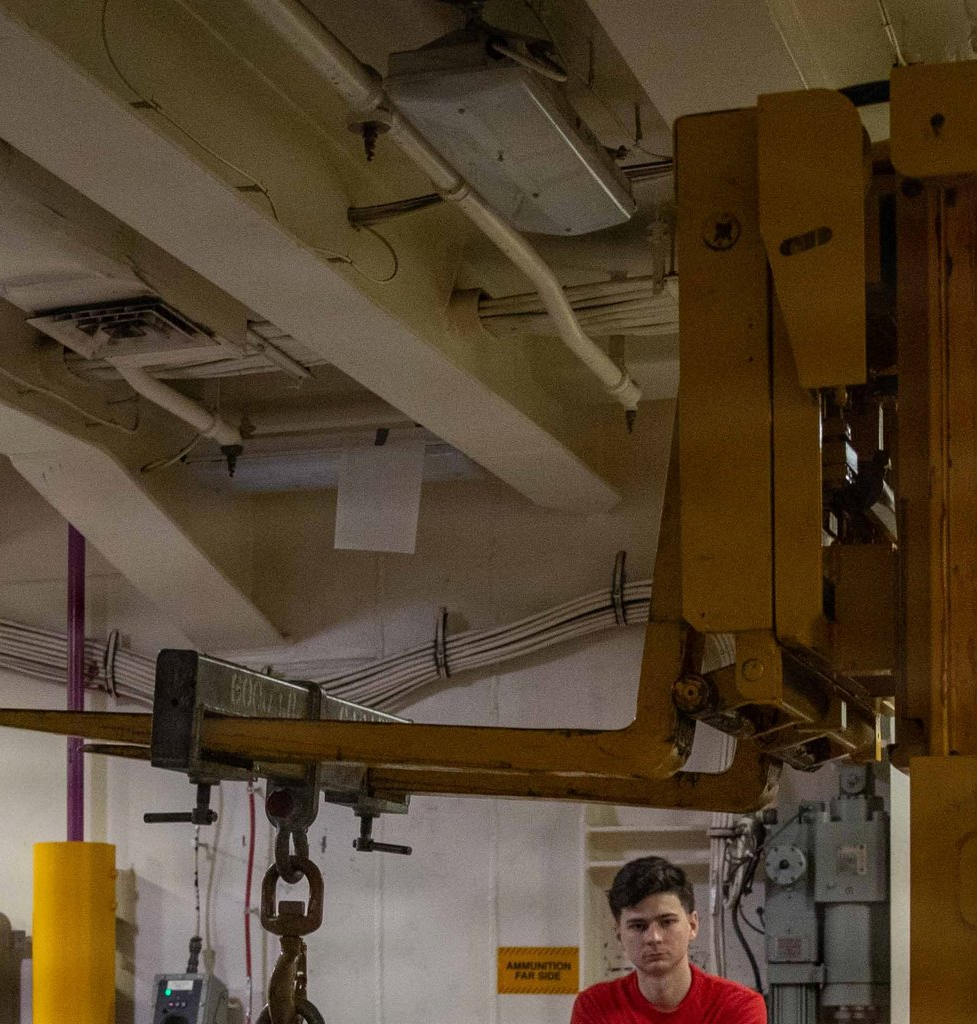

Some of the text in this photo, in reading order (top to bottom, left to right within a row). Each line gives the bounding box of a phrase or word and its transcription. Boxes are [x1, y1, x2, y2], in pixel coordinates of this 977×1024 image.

[506, 961, 572, 971] AMMUNITION
[515, 971, 561, 981] FAR SIDE
